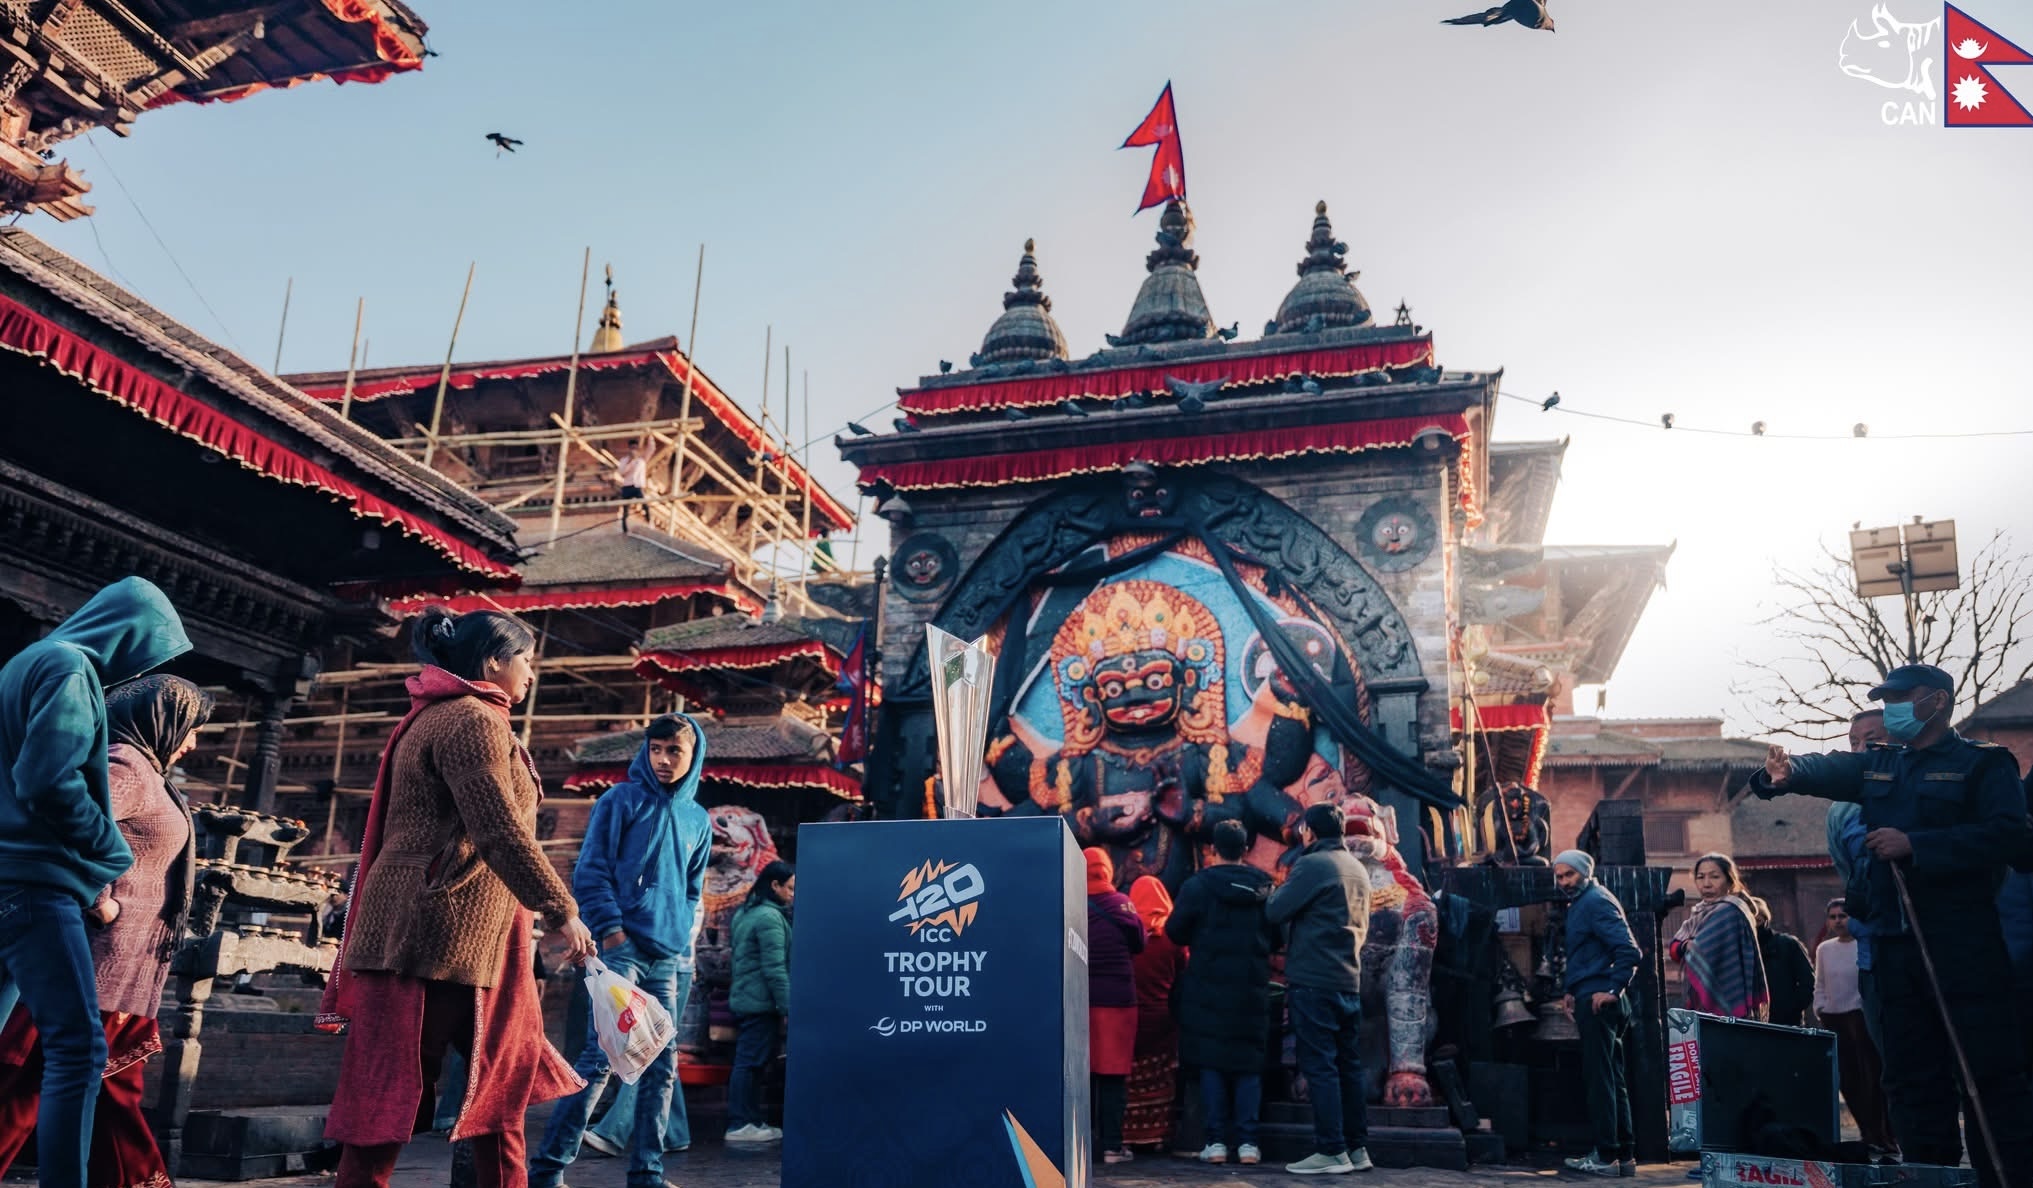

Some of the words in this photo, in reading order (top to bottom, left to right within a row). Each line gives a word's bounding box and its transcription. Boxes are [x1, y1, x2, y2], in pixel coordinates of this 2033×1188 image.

[888, 863, 985, 922] T20
[920, 928, 951, 943] ICC
[883, 951, 988, 972] TROPHY
[899, 976, 971, 997] TOUR
[900, 1020, 923, 1033] DP
[925, 1020, 987, 1033] WORLD
[1669, 1045, 1694, 1100] FRAGILE
